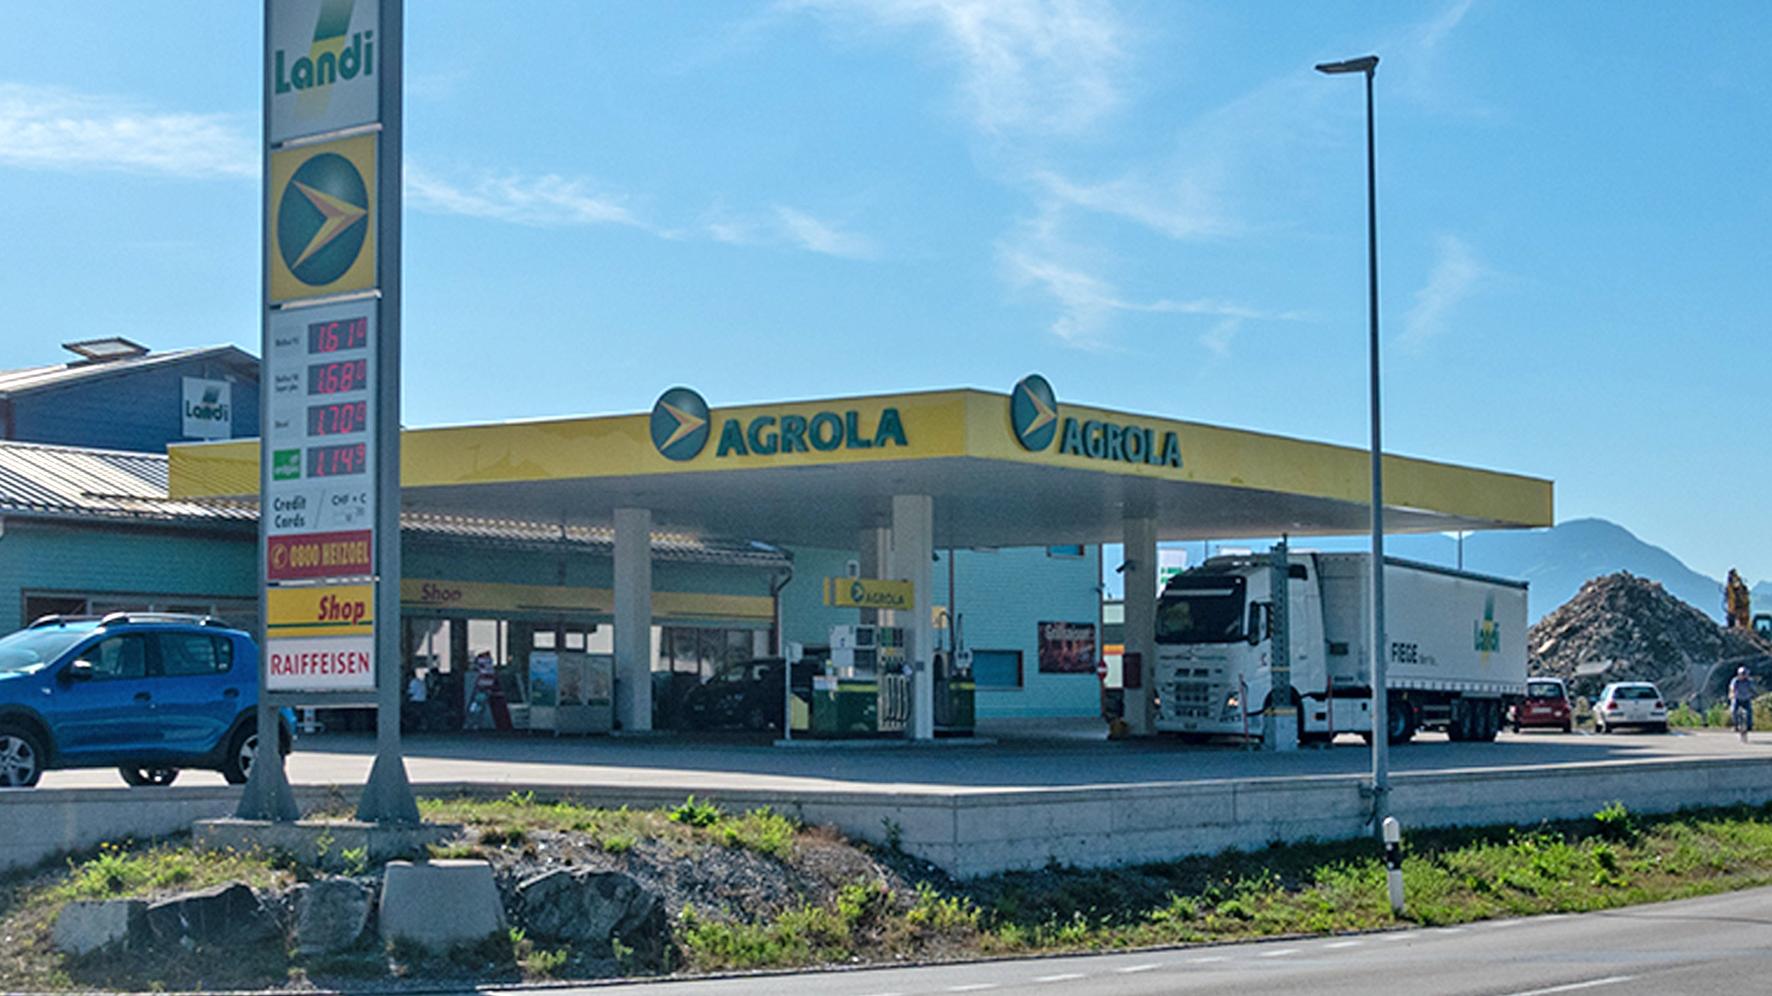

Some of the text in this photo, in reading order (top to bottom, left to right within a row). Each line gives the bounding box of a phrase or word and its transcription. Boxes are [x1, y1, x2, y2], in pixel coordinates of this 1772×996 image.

[275, 30, 373, 94] Landi
[186, 400, 229, 422] Landi
[716, 407, 908, 457] AGROLA
[1059, 417, 1184, 468] AGROLA
[274, 495, 306, 512] Credit
[274, 514, 306, 529] Cards
[290, 540, 369, 568] 0800 HEIZOEL
[318, 595, 365, 625] Shop
[866, 592, 905, 605] AGROLA
[270, 652, 370, 676] RAIFFEISEN
[1392, 642, 1418, 664] FIEGE
